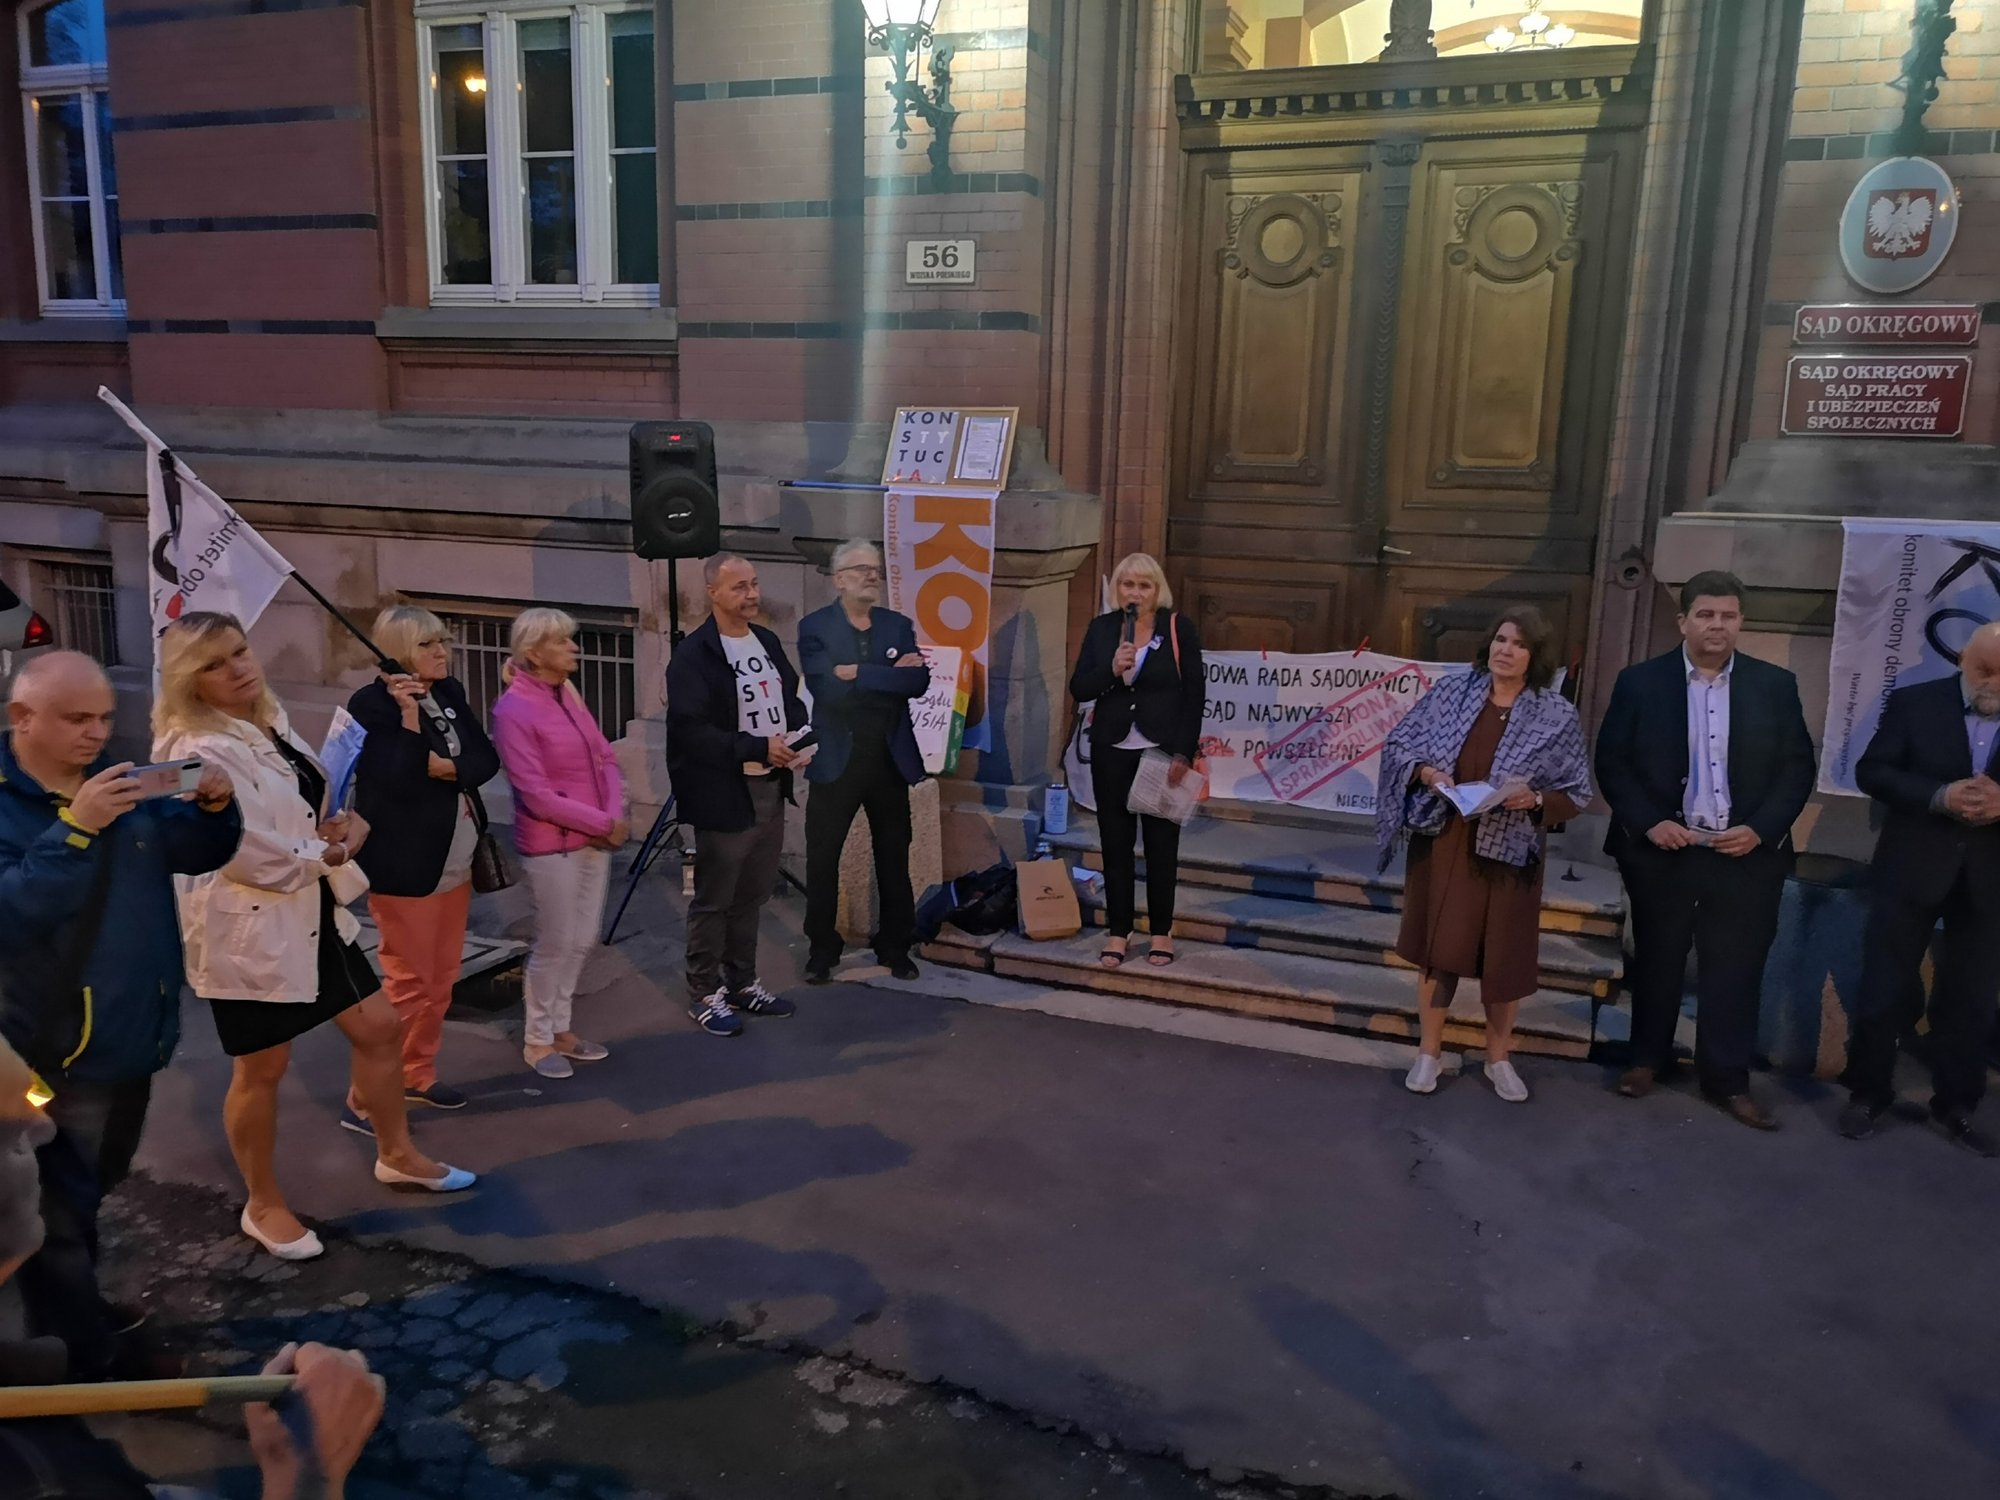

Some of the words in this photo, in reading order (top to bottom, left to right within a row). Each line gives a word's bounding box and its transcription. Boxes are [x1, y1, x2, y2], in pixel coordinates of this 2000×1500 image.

[923, 245, 959, 268] 56
[1800, 316, 1842, 338] SĄD
[1846, 315, 1977, 338] OKRĘGOWY
[1799, 365, 1839, 383] SĄD
[1842, 365, 1960, 383] OKRĘGOWY
[1825, 384, 1862, 399] SĄD
[1865, 384, 1928, 397] PRACY
[1807, 400, 1818, 413] I
[1819, 397, 1942, 414] UBEZPIECZEŃ
[904, 411, 953, 424] KON
[1807, 416, 1938, 430] SPOŁECZNYCH
[901, 430, 950, 443] STY
[899, 449, 945, 463] TUC
[1897, 534, 1924, 594] komitet
[1885, 597, 1912, 653] obrony
[742, 678, 783, 703] ST
[1257, 667, 1303, 687] RADA
[1310, 668, 1433, 695] SĄDOWNICT
[1203, 699, 1235, 723] SĄD
